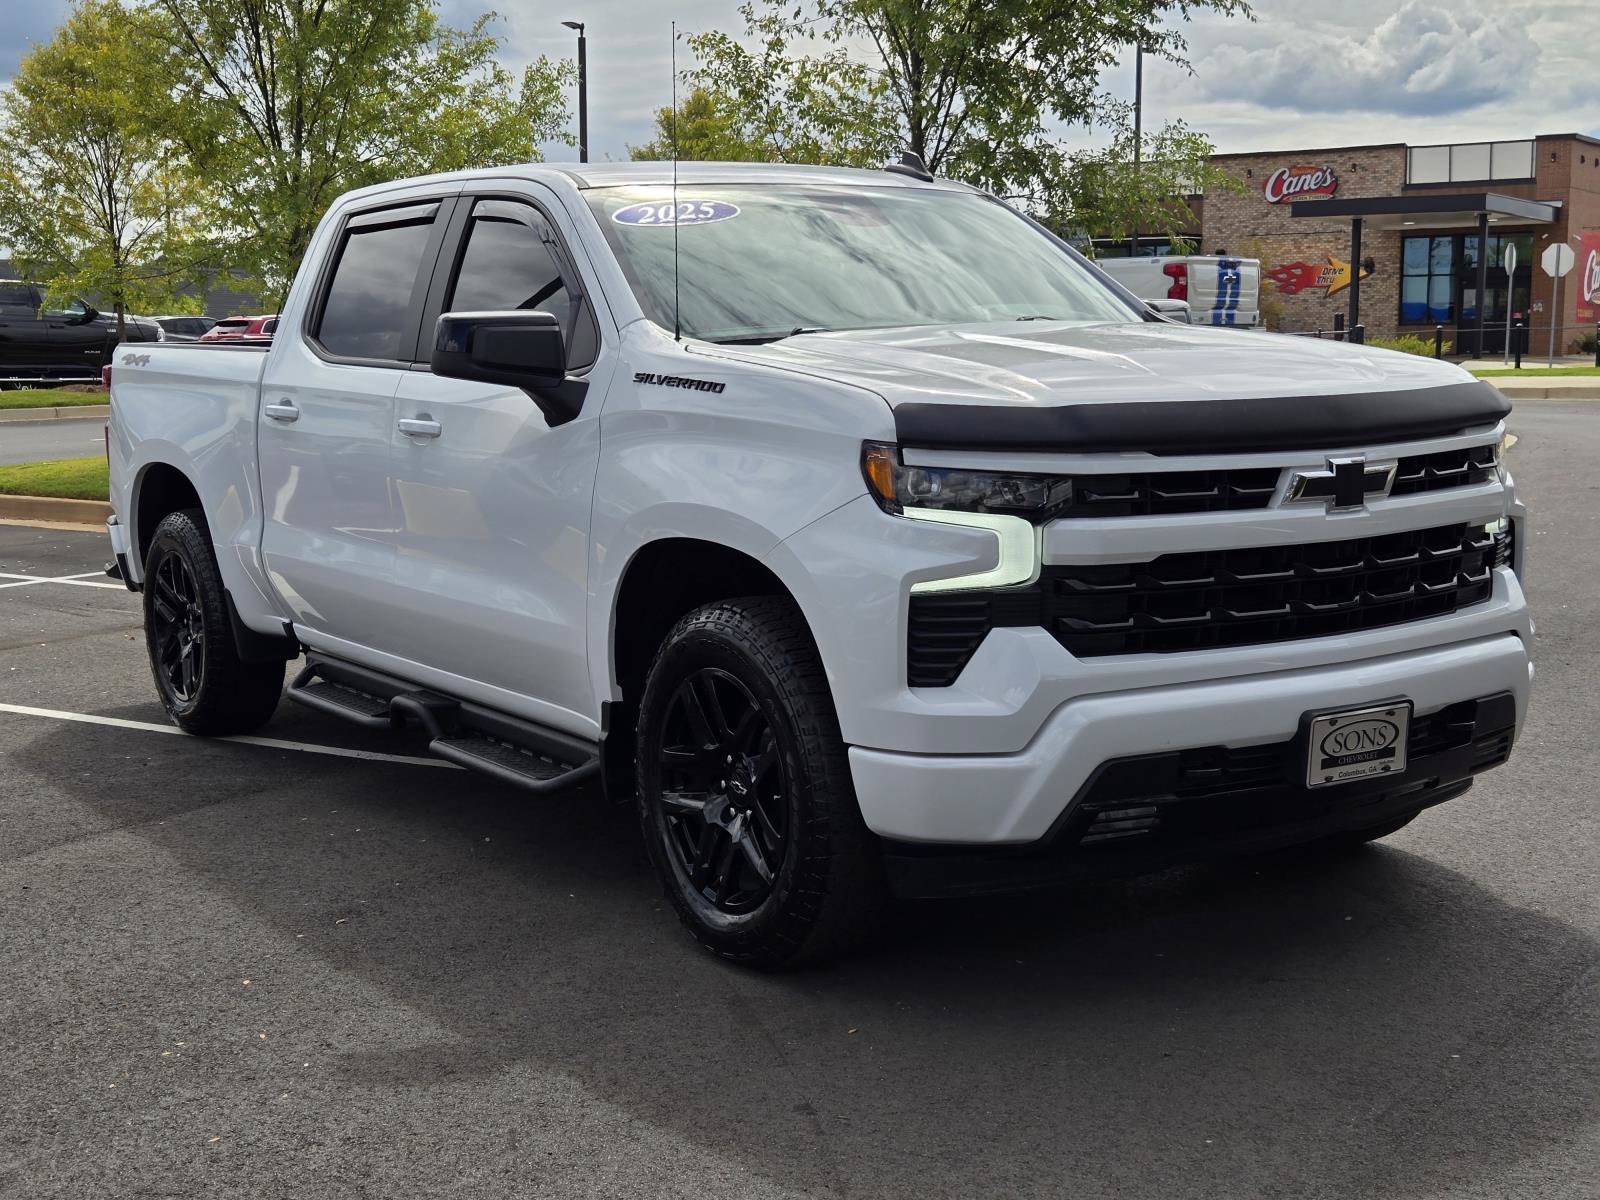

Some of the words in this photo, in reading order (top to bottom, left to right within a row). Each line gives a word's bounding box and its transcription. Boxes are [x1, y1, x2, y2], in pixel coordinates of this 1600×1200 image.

[1265, 165, 1336, 203] Cane's
[638, 202, 715, 223] 2025
[1316, 276, 1334, 284] Thru
[1322, 266, 1344, 276] Drive
[632, 372, 726, 394] SILVERADO
[1332, 725, 1388, 753] SONS
[1338, 751, 1378, 765] CHEVROLET
